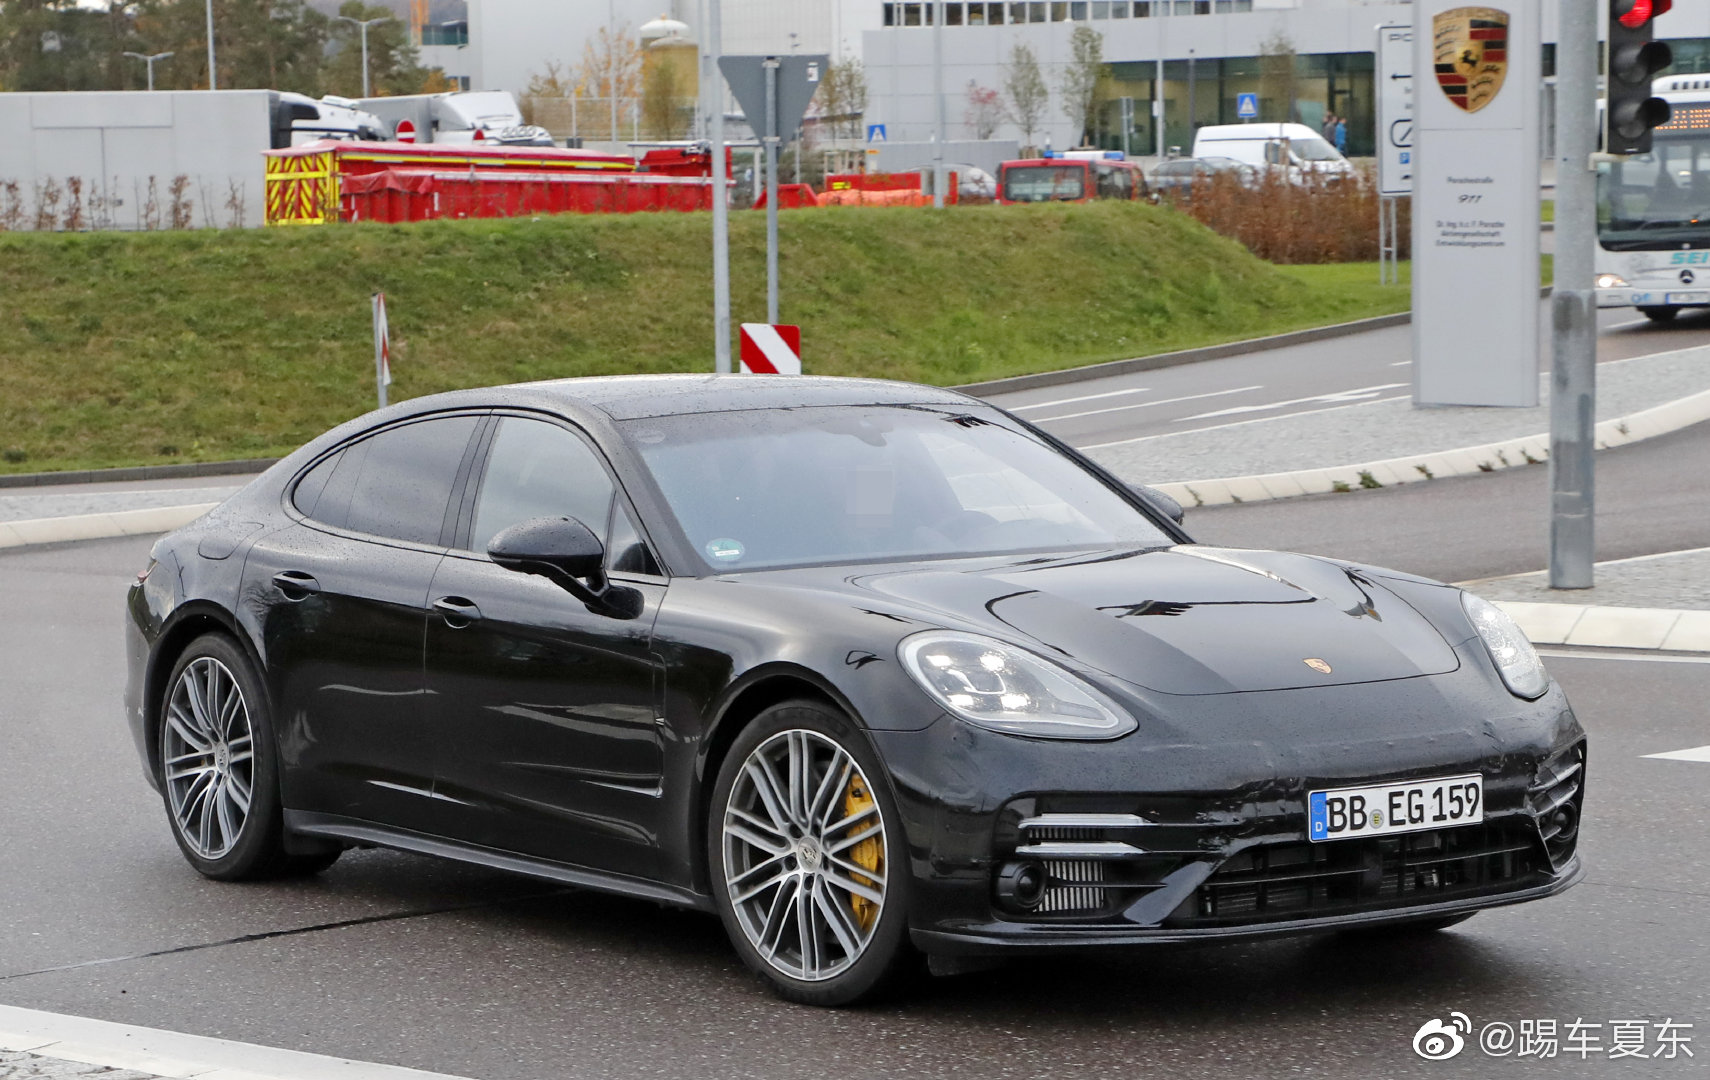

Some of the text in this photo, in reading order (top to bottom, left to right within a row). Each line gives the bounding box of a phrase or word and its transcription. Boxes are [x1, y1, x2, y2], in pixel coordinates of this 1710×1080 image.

[1458, 194, 1483, 204] 911
[1315, 782, 1480, 833] D BB EG 159
